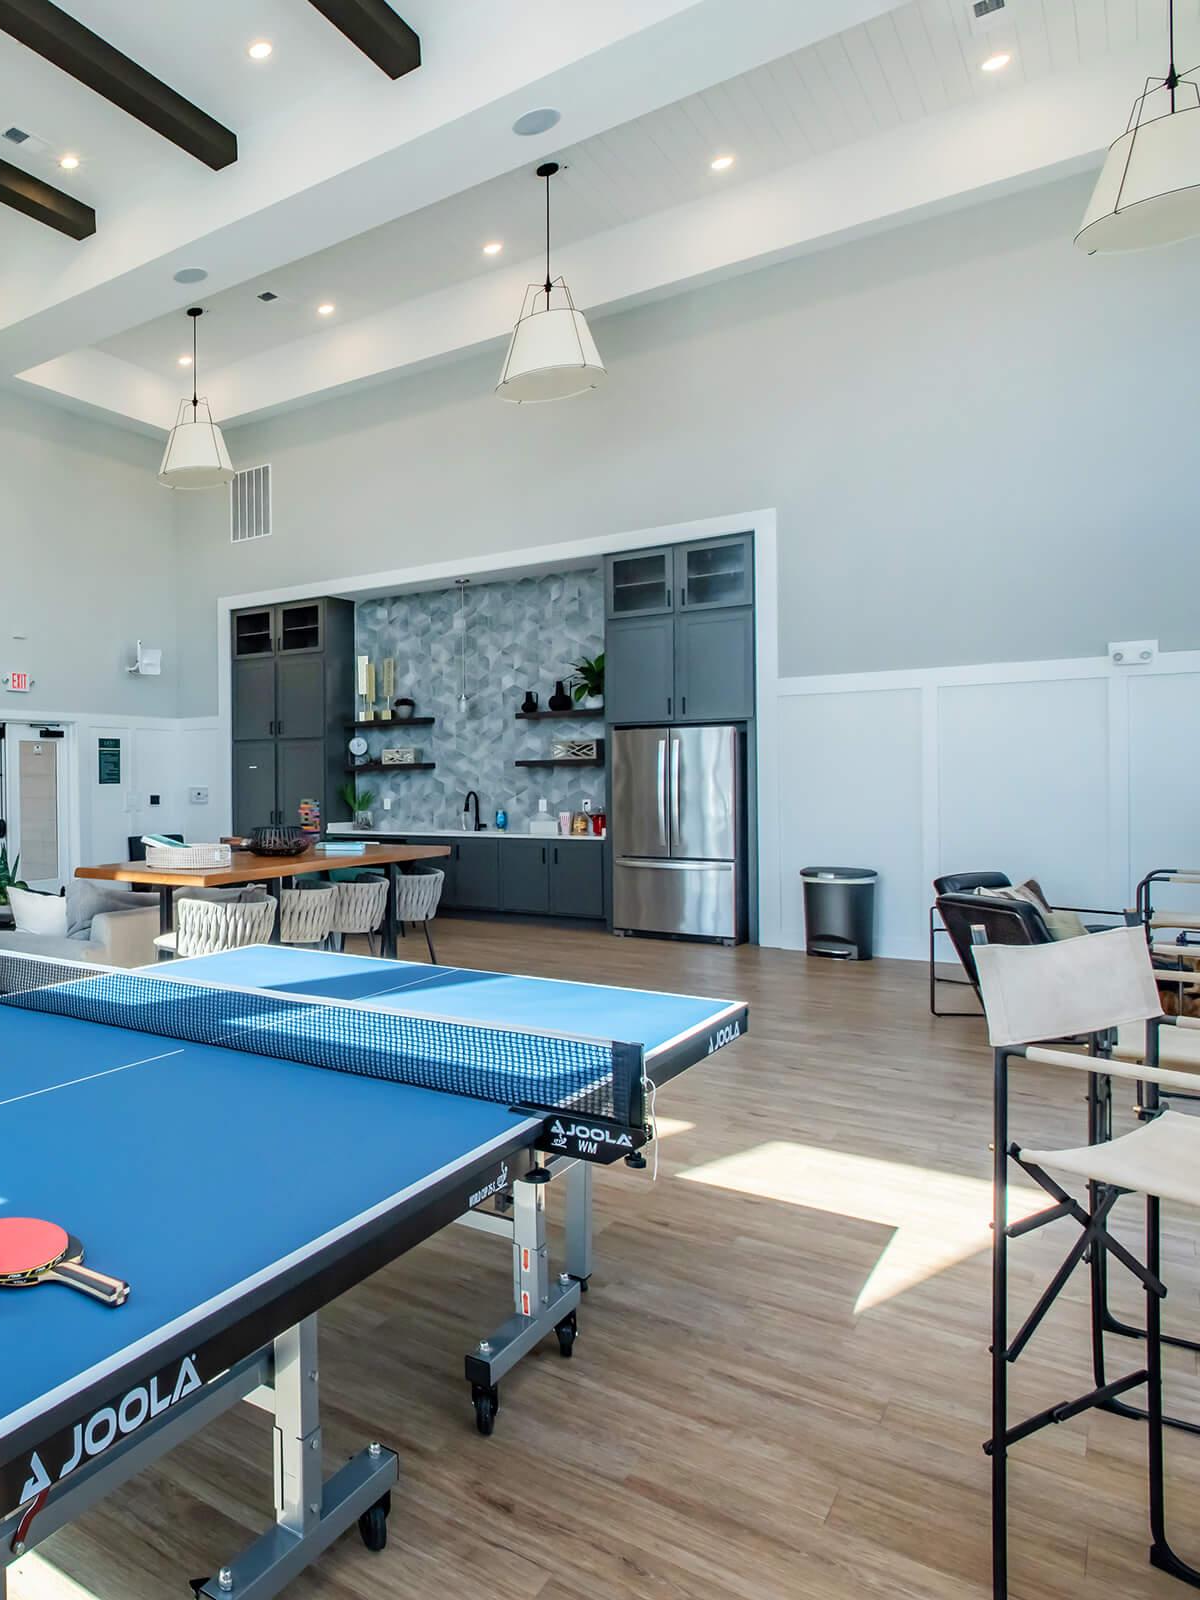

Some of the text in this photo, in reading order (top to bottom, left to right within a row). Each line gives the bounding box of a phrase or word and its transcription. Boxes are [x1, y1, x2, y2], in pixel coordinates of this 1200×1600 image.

[12, 673, 27, 688] EXIT
[715, 1021, 741, 1050] JOOLA
[566, 1124, 633, 1147] JOOLA
[578, 1139, 598, 1154] WM
[59, 1355, 204, 1479] JOOLA
